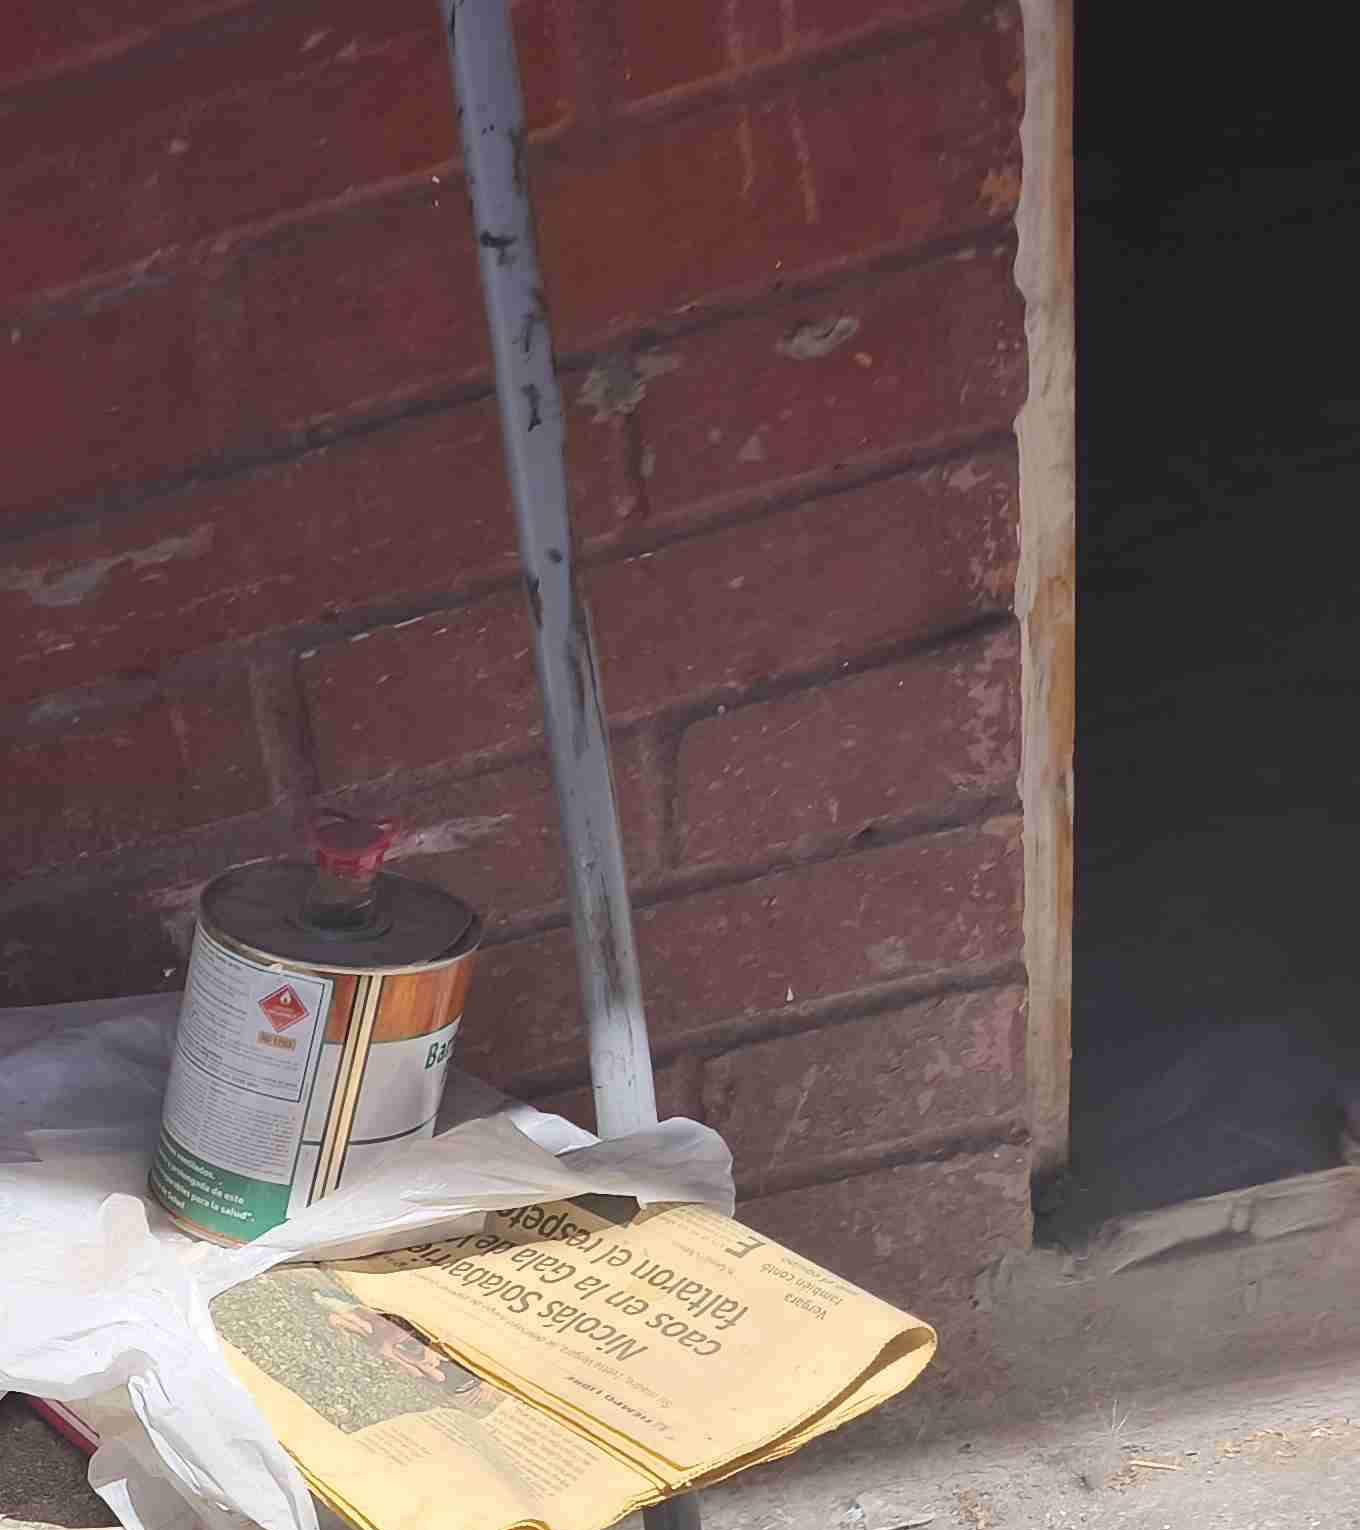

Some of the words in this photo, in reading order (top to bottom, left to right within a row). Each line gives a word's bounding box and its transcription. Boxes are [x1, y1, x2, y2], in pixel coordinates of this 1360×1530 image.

[474, 1233, 517, 1257] de
[590, 1243, 633, 1268] el
[511, 1247, 577, 1284] Gala
[574, 1275, 610, 1300] la
[630, 1259, 749, 1331] faltaron
[605, 1290, 649, 1316] en
[783, 1293, 829, 1321] Vergara
[537, 1300, 648, 1362] Nicolás
[645, 1312, 722, 1356] caos
